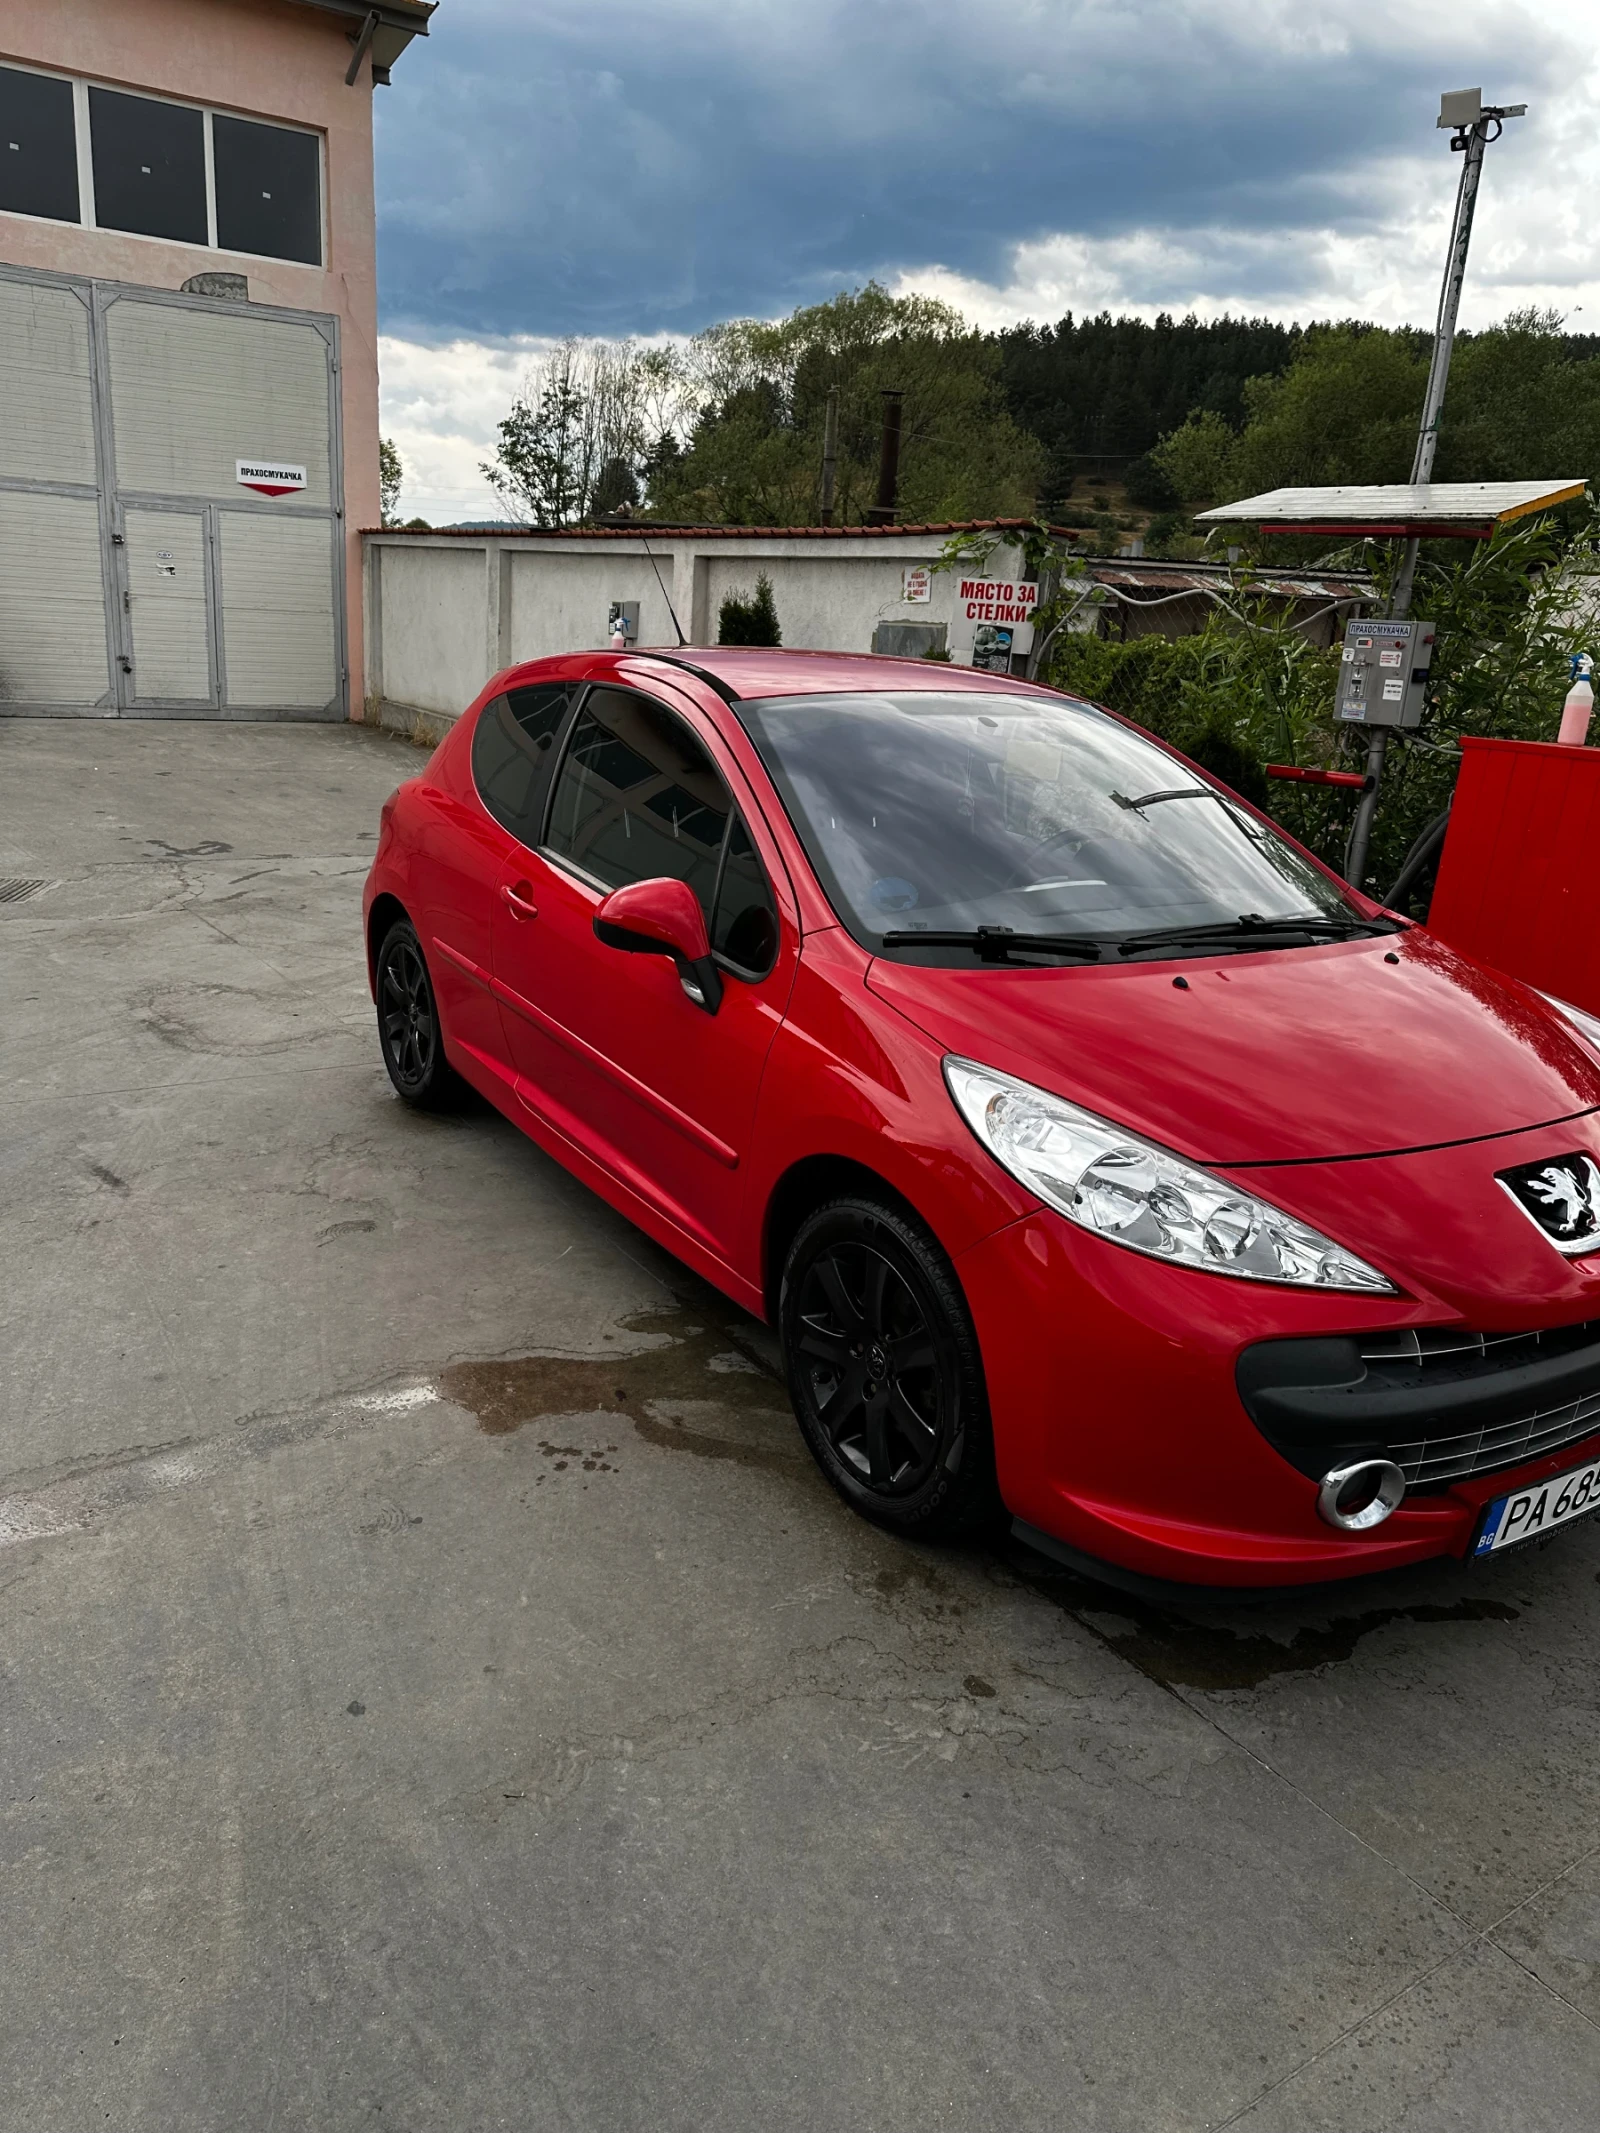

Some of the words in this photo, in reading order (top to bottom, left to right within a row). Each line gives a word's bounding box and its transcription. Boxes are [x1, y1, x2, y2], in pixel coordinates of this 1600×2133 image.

[241, 467, 302, 480] ПРАХОСМУКАЧКА
[960, 581, 1013, 601] МЯСТО
[1017, 584, 1036, 603] ЗА
[966, 602, 1027, 622] СТЕЛКИ
[1351, 624, 1408, 635] ПРАХОСМУКАЧКА
[1478, 1532, 1495, 1548] BG
[1500, 1488, 1548, 1541] PA
